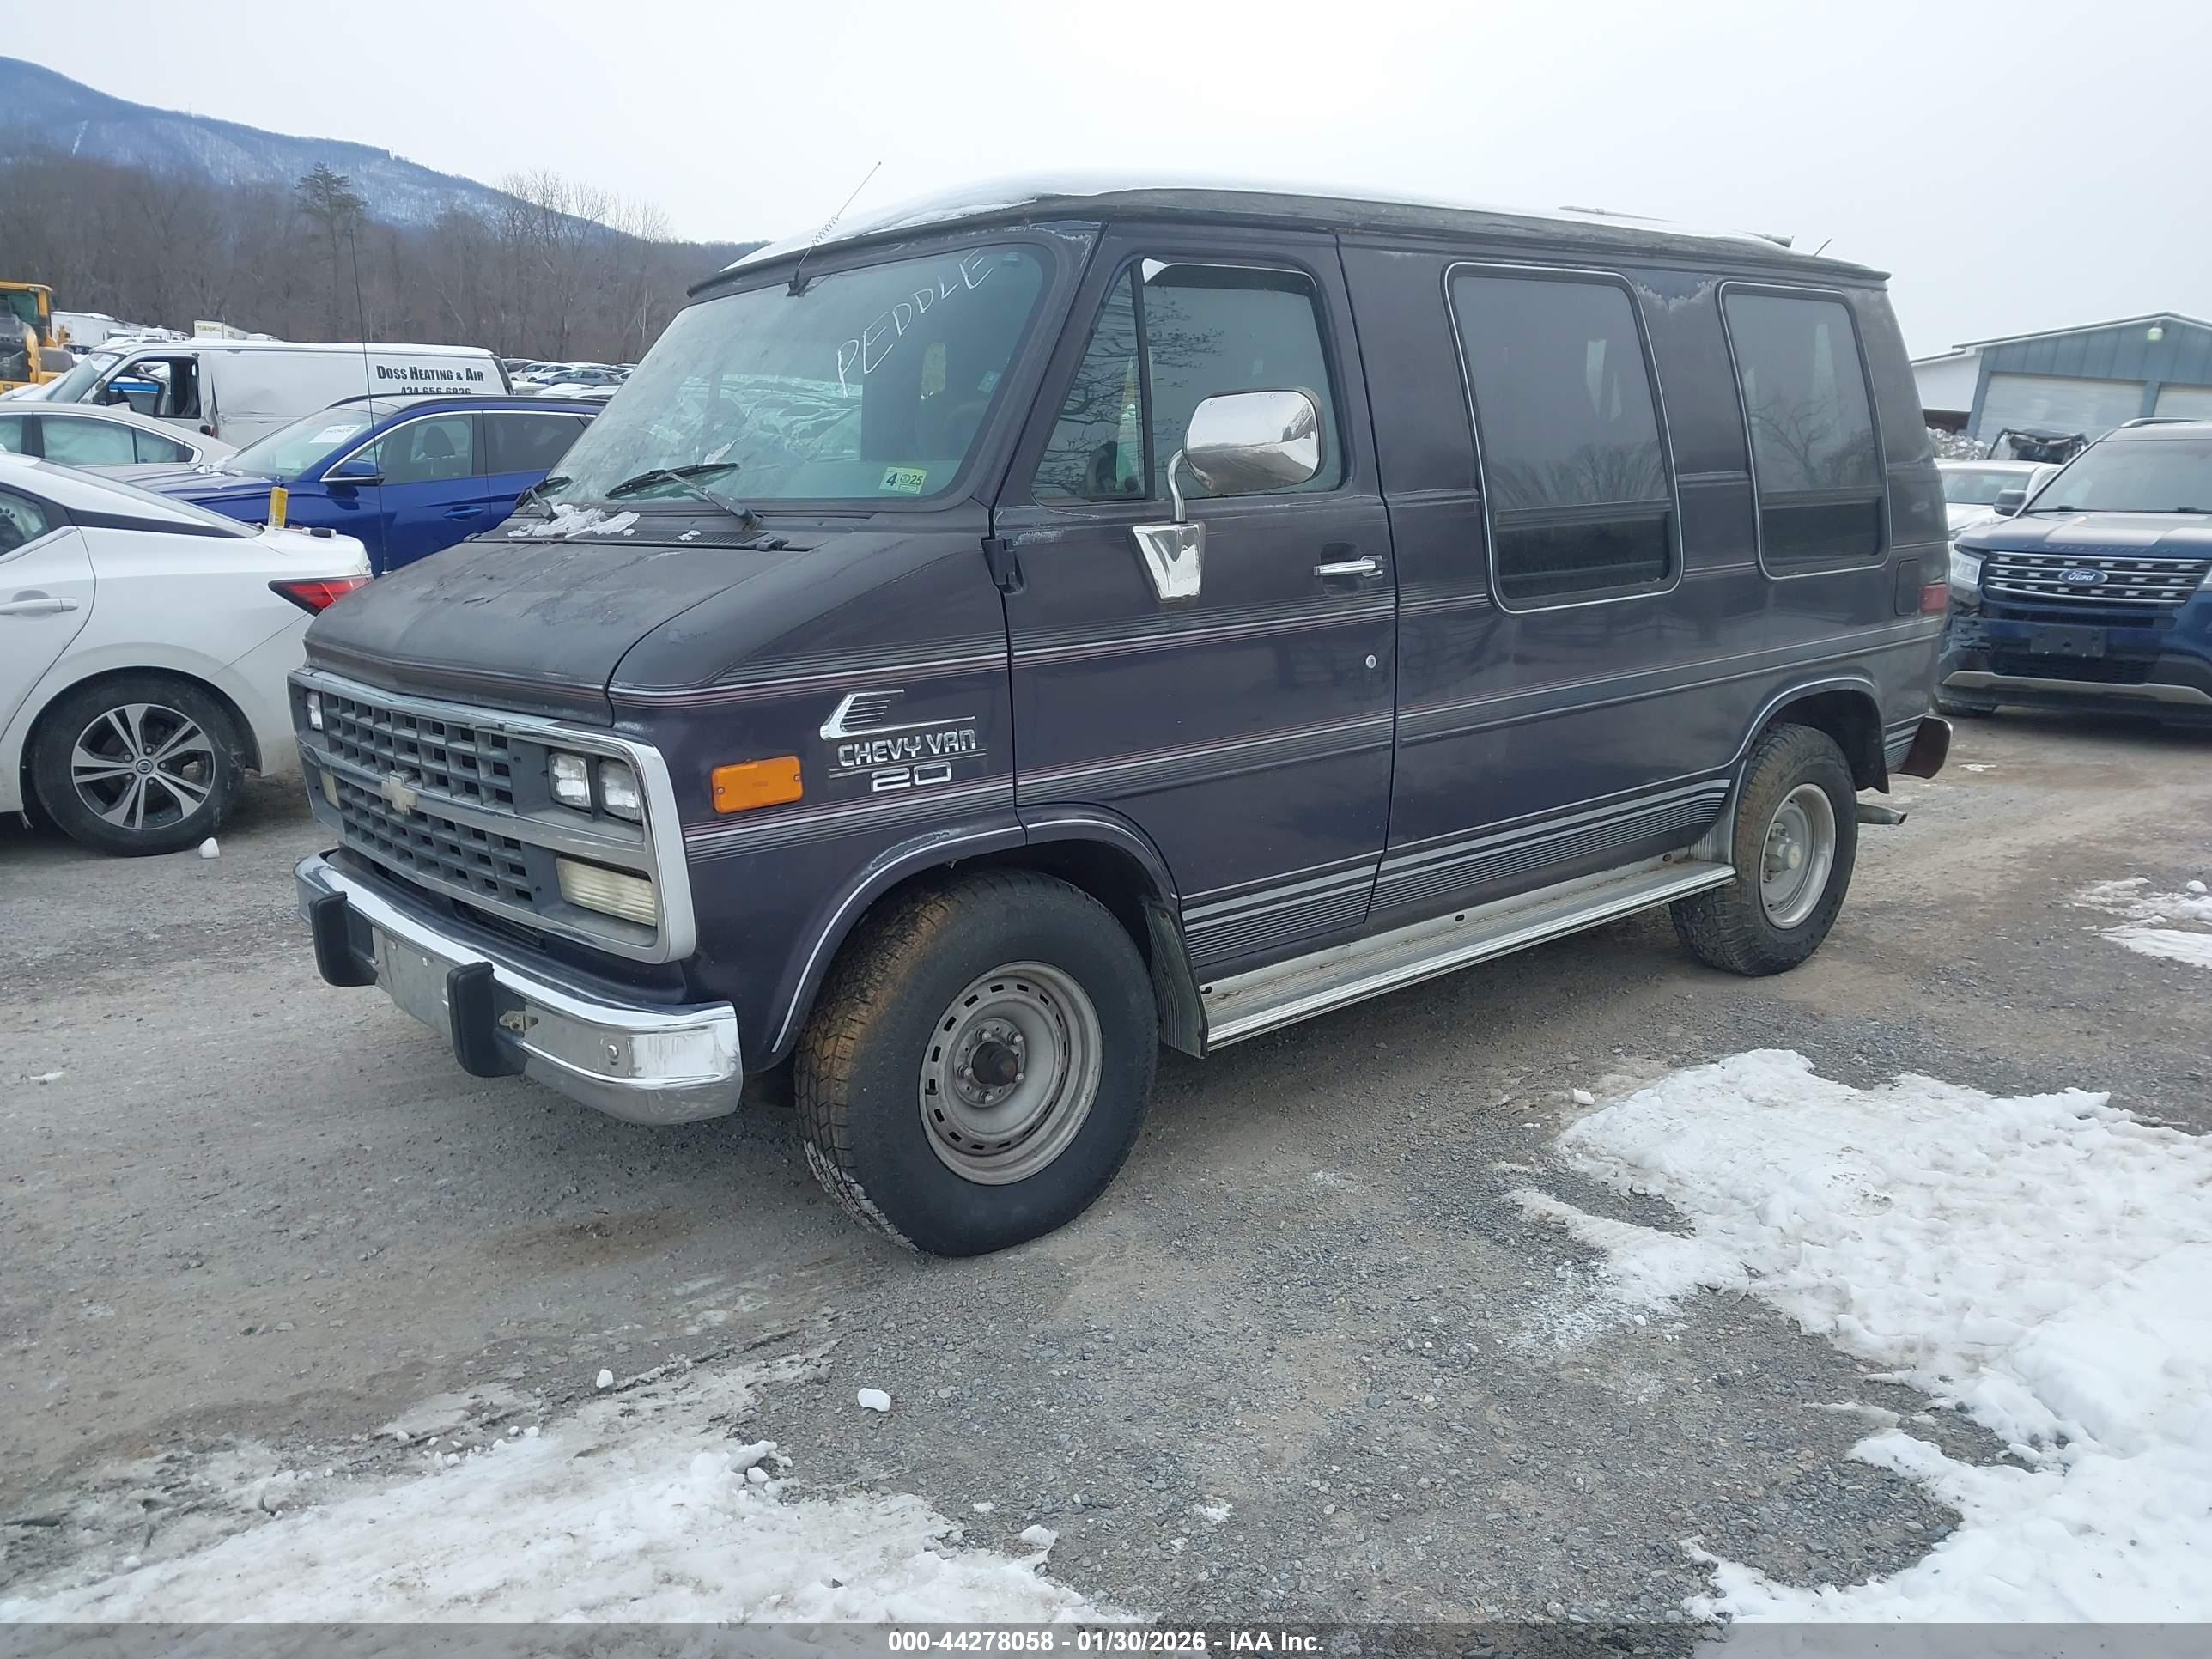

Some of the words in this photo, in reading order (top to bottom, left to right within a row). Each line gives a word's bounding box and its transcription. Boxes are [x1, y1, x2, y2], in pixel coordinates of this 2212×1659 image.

[837, 248, 994, 399] PEDDLE
[456, 371, 463, 380] &
[885, 472, 898, 486] 4
[909, 474, 924, 486] 25
[2068, 570, 2096, 582] Ford
[837, 734, 921, 767] CHEVY
[927, 728, 976, 753] VAN
[871, 761, 953, 792] 20
